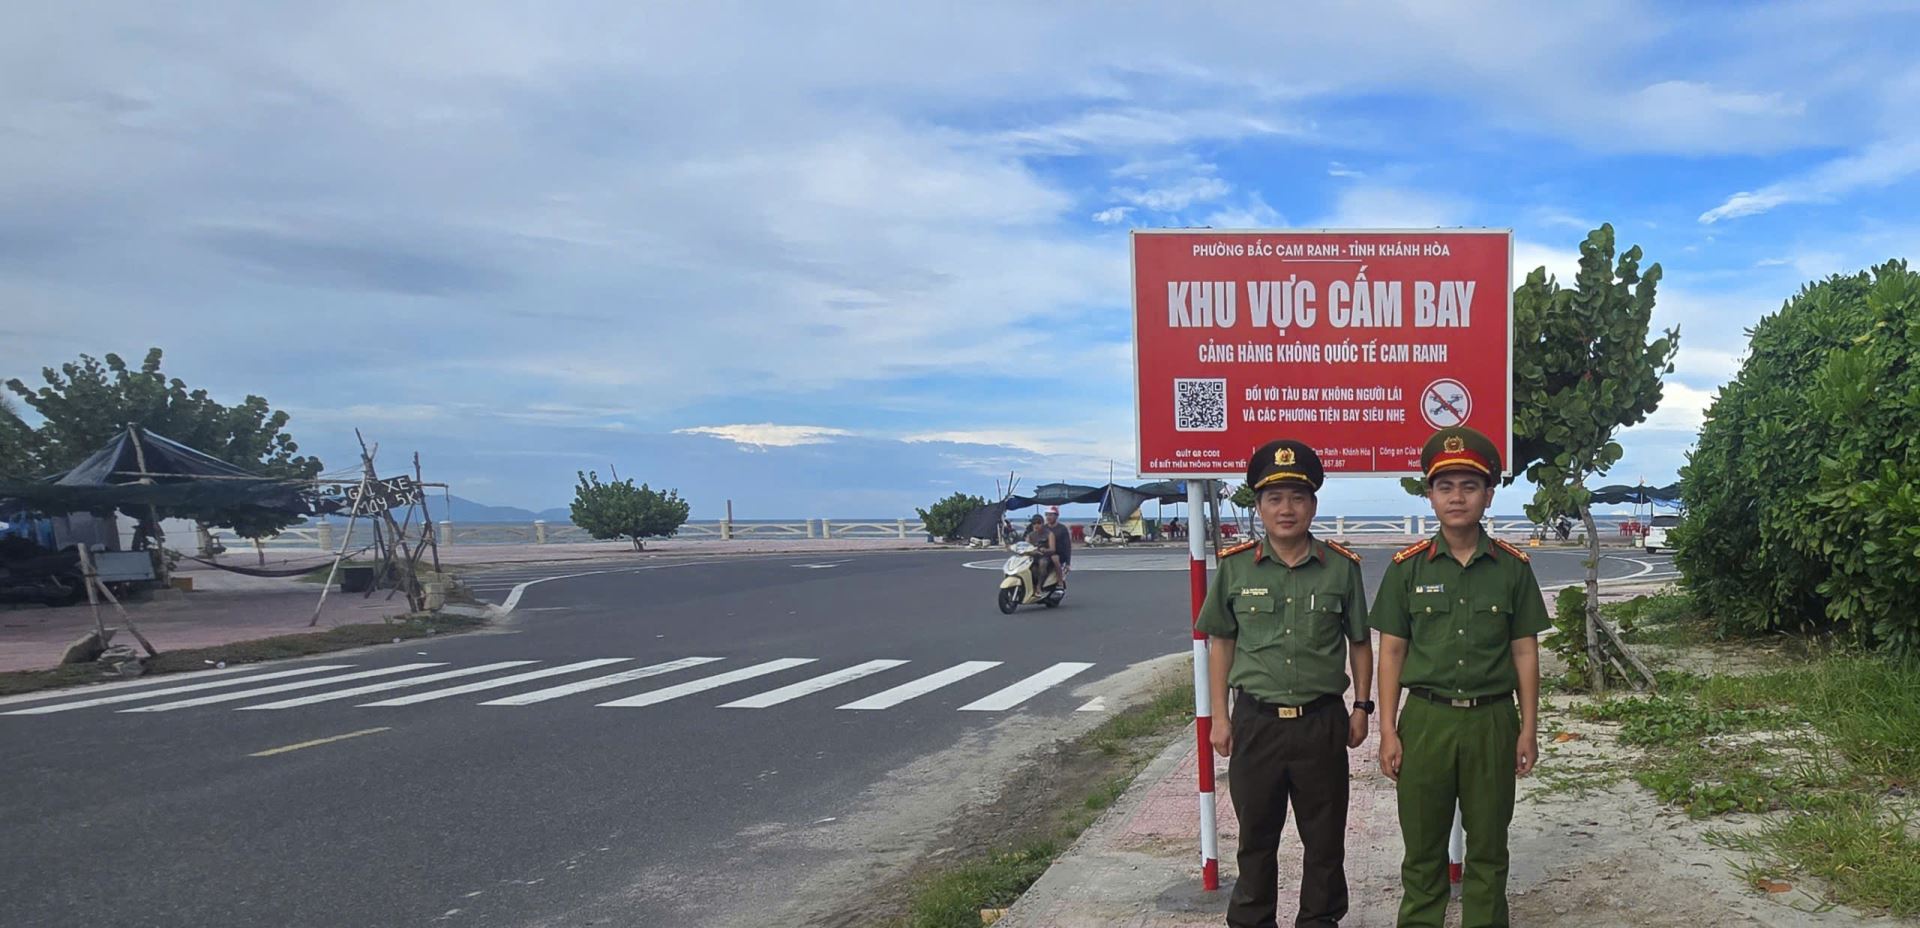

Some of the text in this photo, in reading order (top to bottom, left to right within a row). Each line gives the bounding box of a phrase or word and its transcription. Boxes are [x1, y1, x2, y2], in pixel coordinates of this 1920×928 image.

[1193, 241, 1244, 257] PHƯỜNG
[1247, 239, 1273, 257] BẮC
[1276, 244, 1303, 257] CAM
[1307, 244, 1340, 257] RANH
[1349, 242, 1376, 257] TỈNH
[1379, 241, 1420, 257] KHÁNH
[1424, 241, 1450, 257] HÒA
[1167, 264, 1476, 337] KHU VỰC CẤM BAY
[1199, 337, 1448, 364] CẢNG HÀNG KHÔNG QUỐC TẾ CAM RANH
[1245, 384, 1402, 401] ĐỐI VỚI TÀU BAY KHÔNG NGƯỜI LÁI
[1242, 406, 1406, 424] VÀ CÁC PHƯƠNG TIỆN BAY SIÊU NHẸ
[1203, 450, 1220, 458] CODE
[1379, 446, 1396, 458] Công
[1189, 459, 1210, 469] THÔNG
[1212, 460, 1222, 469] TIN
[1223, 460, 1234, 469] CHI
[381, 477, 409, 493] XE
